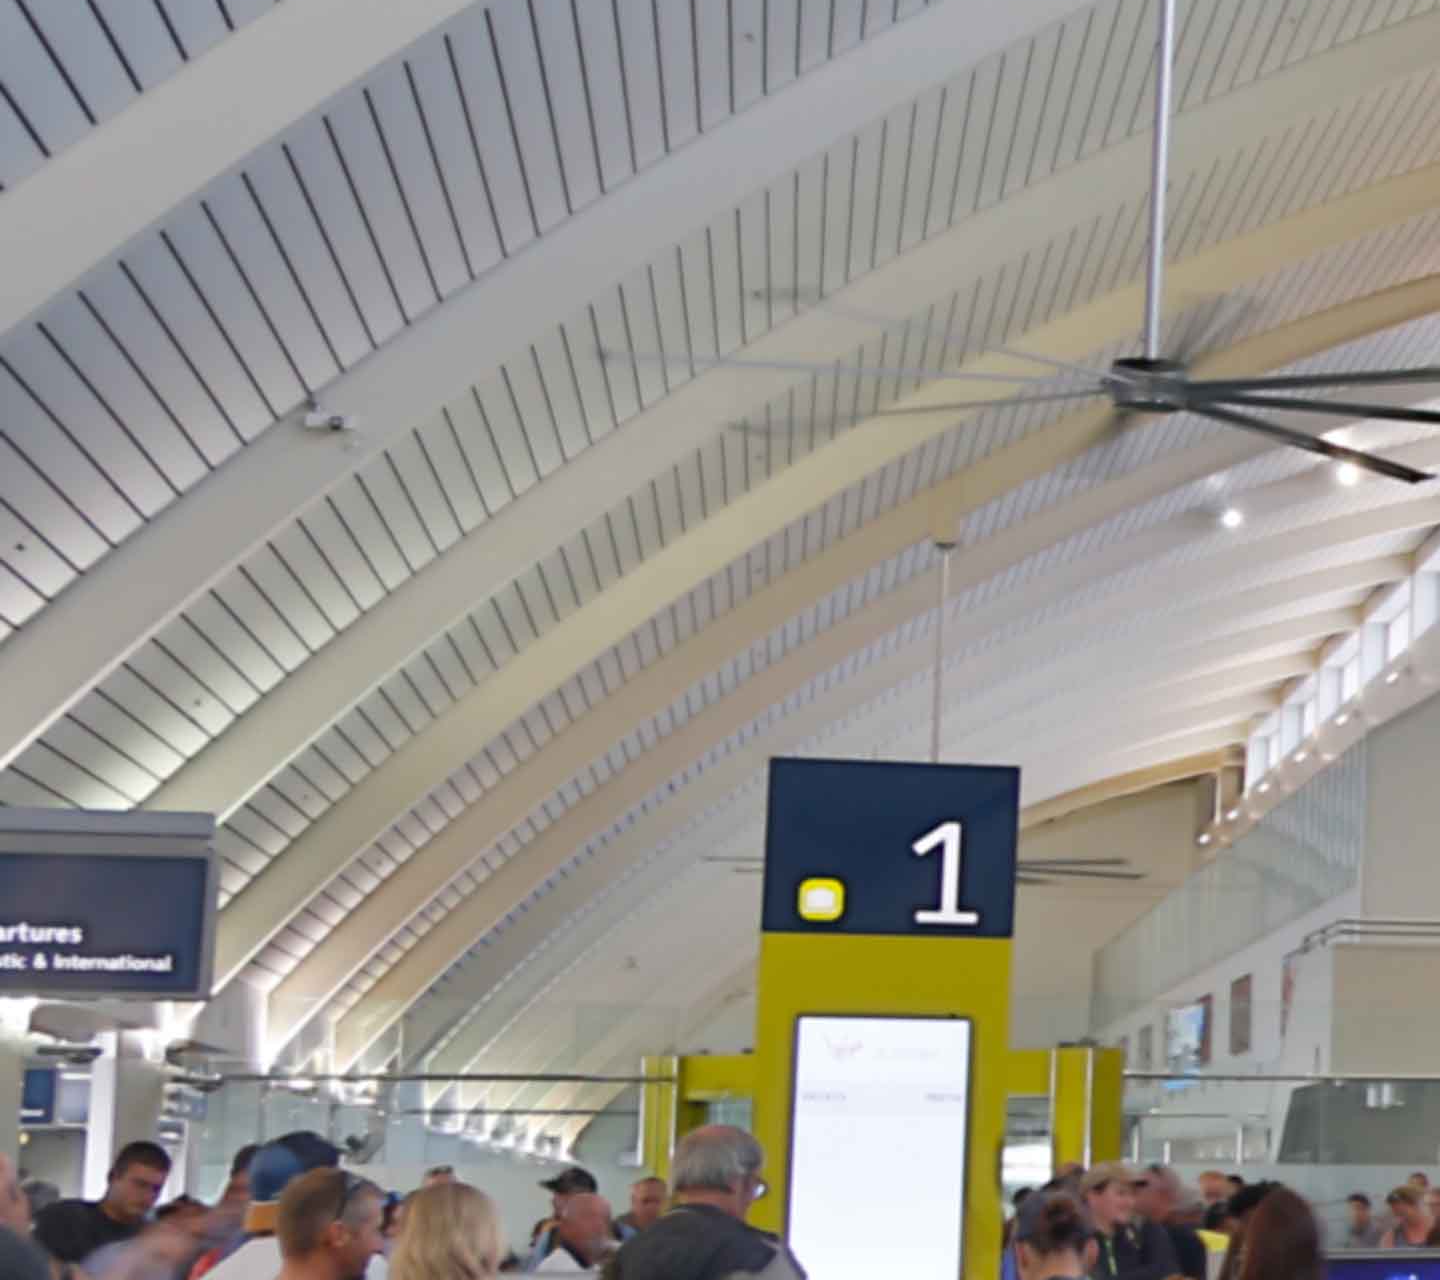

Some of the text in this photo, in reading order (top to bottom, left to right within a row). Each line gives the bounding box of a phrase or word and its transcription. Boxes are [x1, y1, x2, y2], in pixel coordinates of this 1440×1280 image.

[911, 820, 980, 925] 1
[33, 952, 48, 970] &
[53, 953, 173, 971] International
